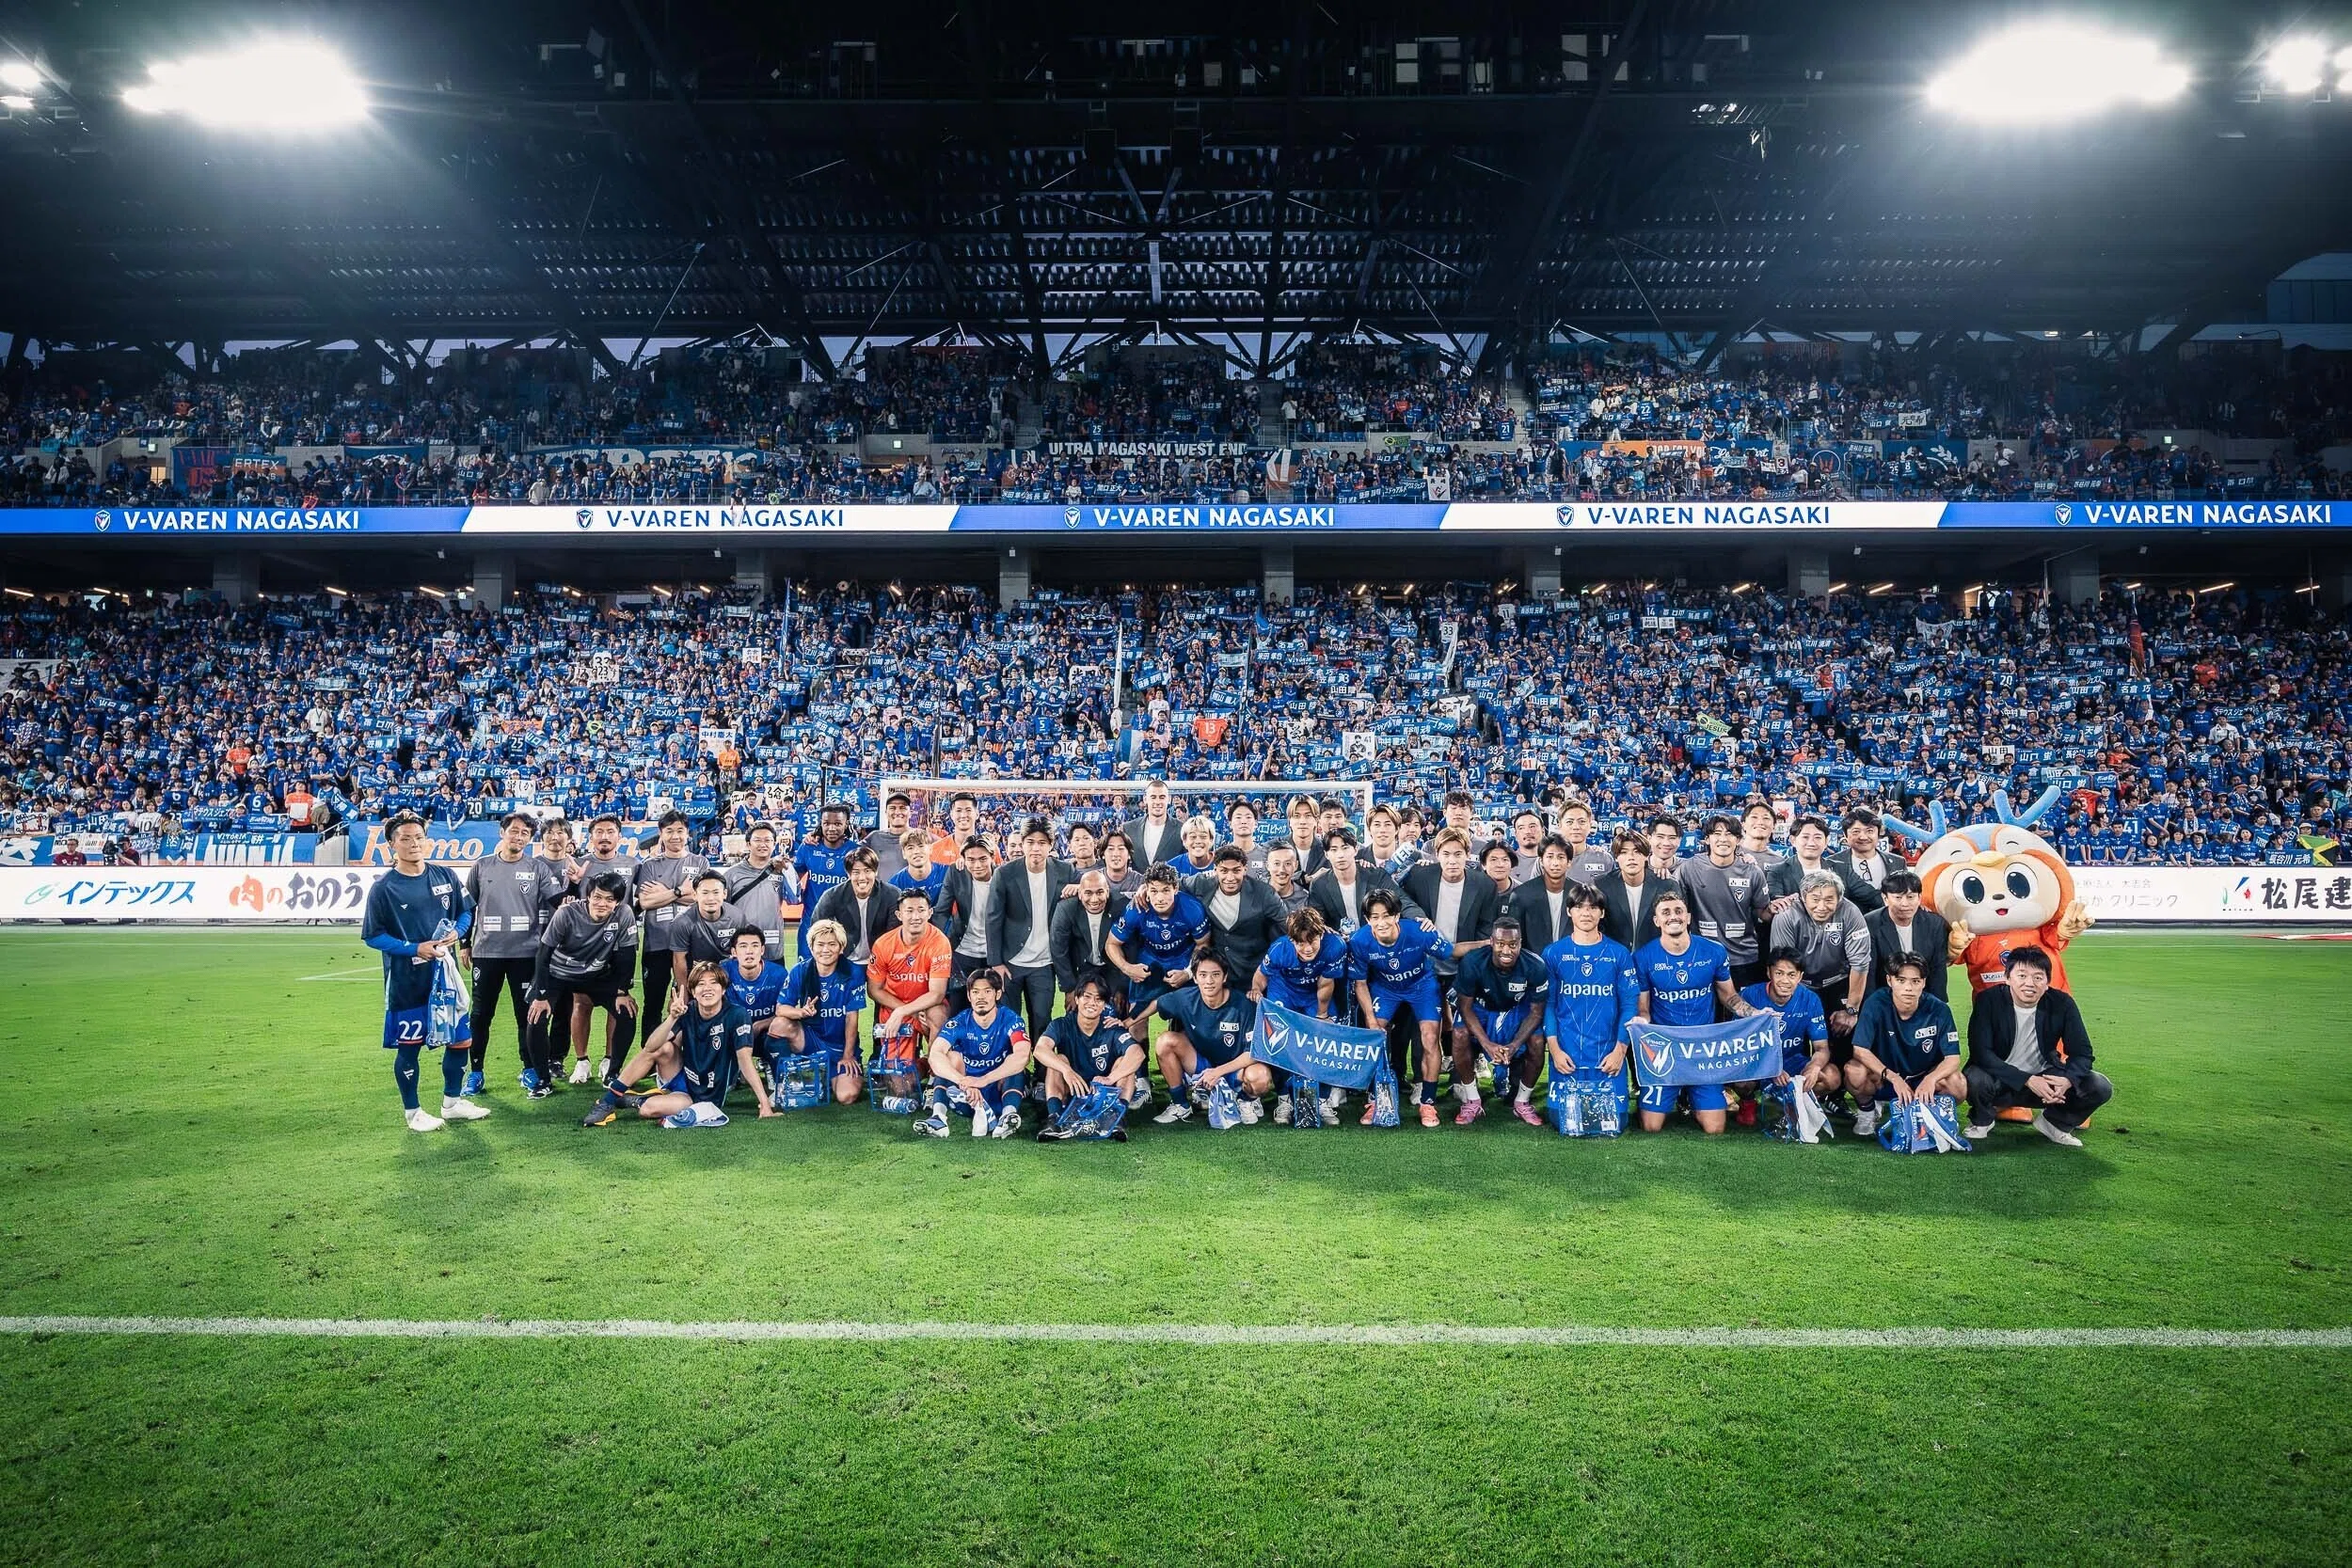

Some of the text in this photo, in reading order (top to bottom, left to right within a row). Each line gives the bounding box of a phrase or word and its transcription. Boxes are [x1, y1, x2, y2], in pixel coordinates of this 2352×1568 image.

[1640, 405, 1651, 415] 22
[1098, 442, 1169, 455] NAGASAKI
[1174, 442, 1213, 455] WEST
[234, 458, 279, 470] ERTEX
[124, 511, 358, 530] V-VAREN NAGASAKI
[607, 510, 843, 528] V-VAREN NAGASAKI
[1093, 508, 1334, 527] V-VAREN NAGASAKI
[1588, 506, 1829, 525] V-VAREN NAGASAKI
[2085, 504, 2330, 524] V-VAREN NAGASAKI
[1443, 626, 1454, 636] 33
[2000, 675, 2013, 686] 20
[1039, 719, 1045, 728] 5
[1204, 721, 1216, 735] 13
[511, 736, 523, 749] 25
[1522, 760, 1533, 768] 41
[1469, 768, 1481, 780] 21
[252, 795, 262, 808] 6
[468, 800, 483, 815] 20
[140, 820, 153, 832] 10
[803, 814, 819, 826] 33
[2123, 820, 2138, 834] 41
[348, 825, 485, 863] Rmo
[809, 870, 848, 884] Japane
[58, 881, 196, 905] インテックス
[229, 871, 379, 912] 肉のおのう
[2261, 876, 2352, 911] 松尾建
[1560, 980, 1614, 998] Japanet
[1654, 983, 1712, 1003] Japanet
[820, 1006, 847, 1018] anet
[399, 1021, 422, 1040] 22
[1295, 1030, 1380, 1062] V-VAREN
[1679, 1029, 1774, 1060] V-VAREN
[1306, 1054, 1361, 1071] NAGASAKI
[1698, 1053, 1760, 1070] NAGASAKI
[1642, 1085, 1663, 1106] 21
